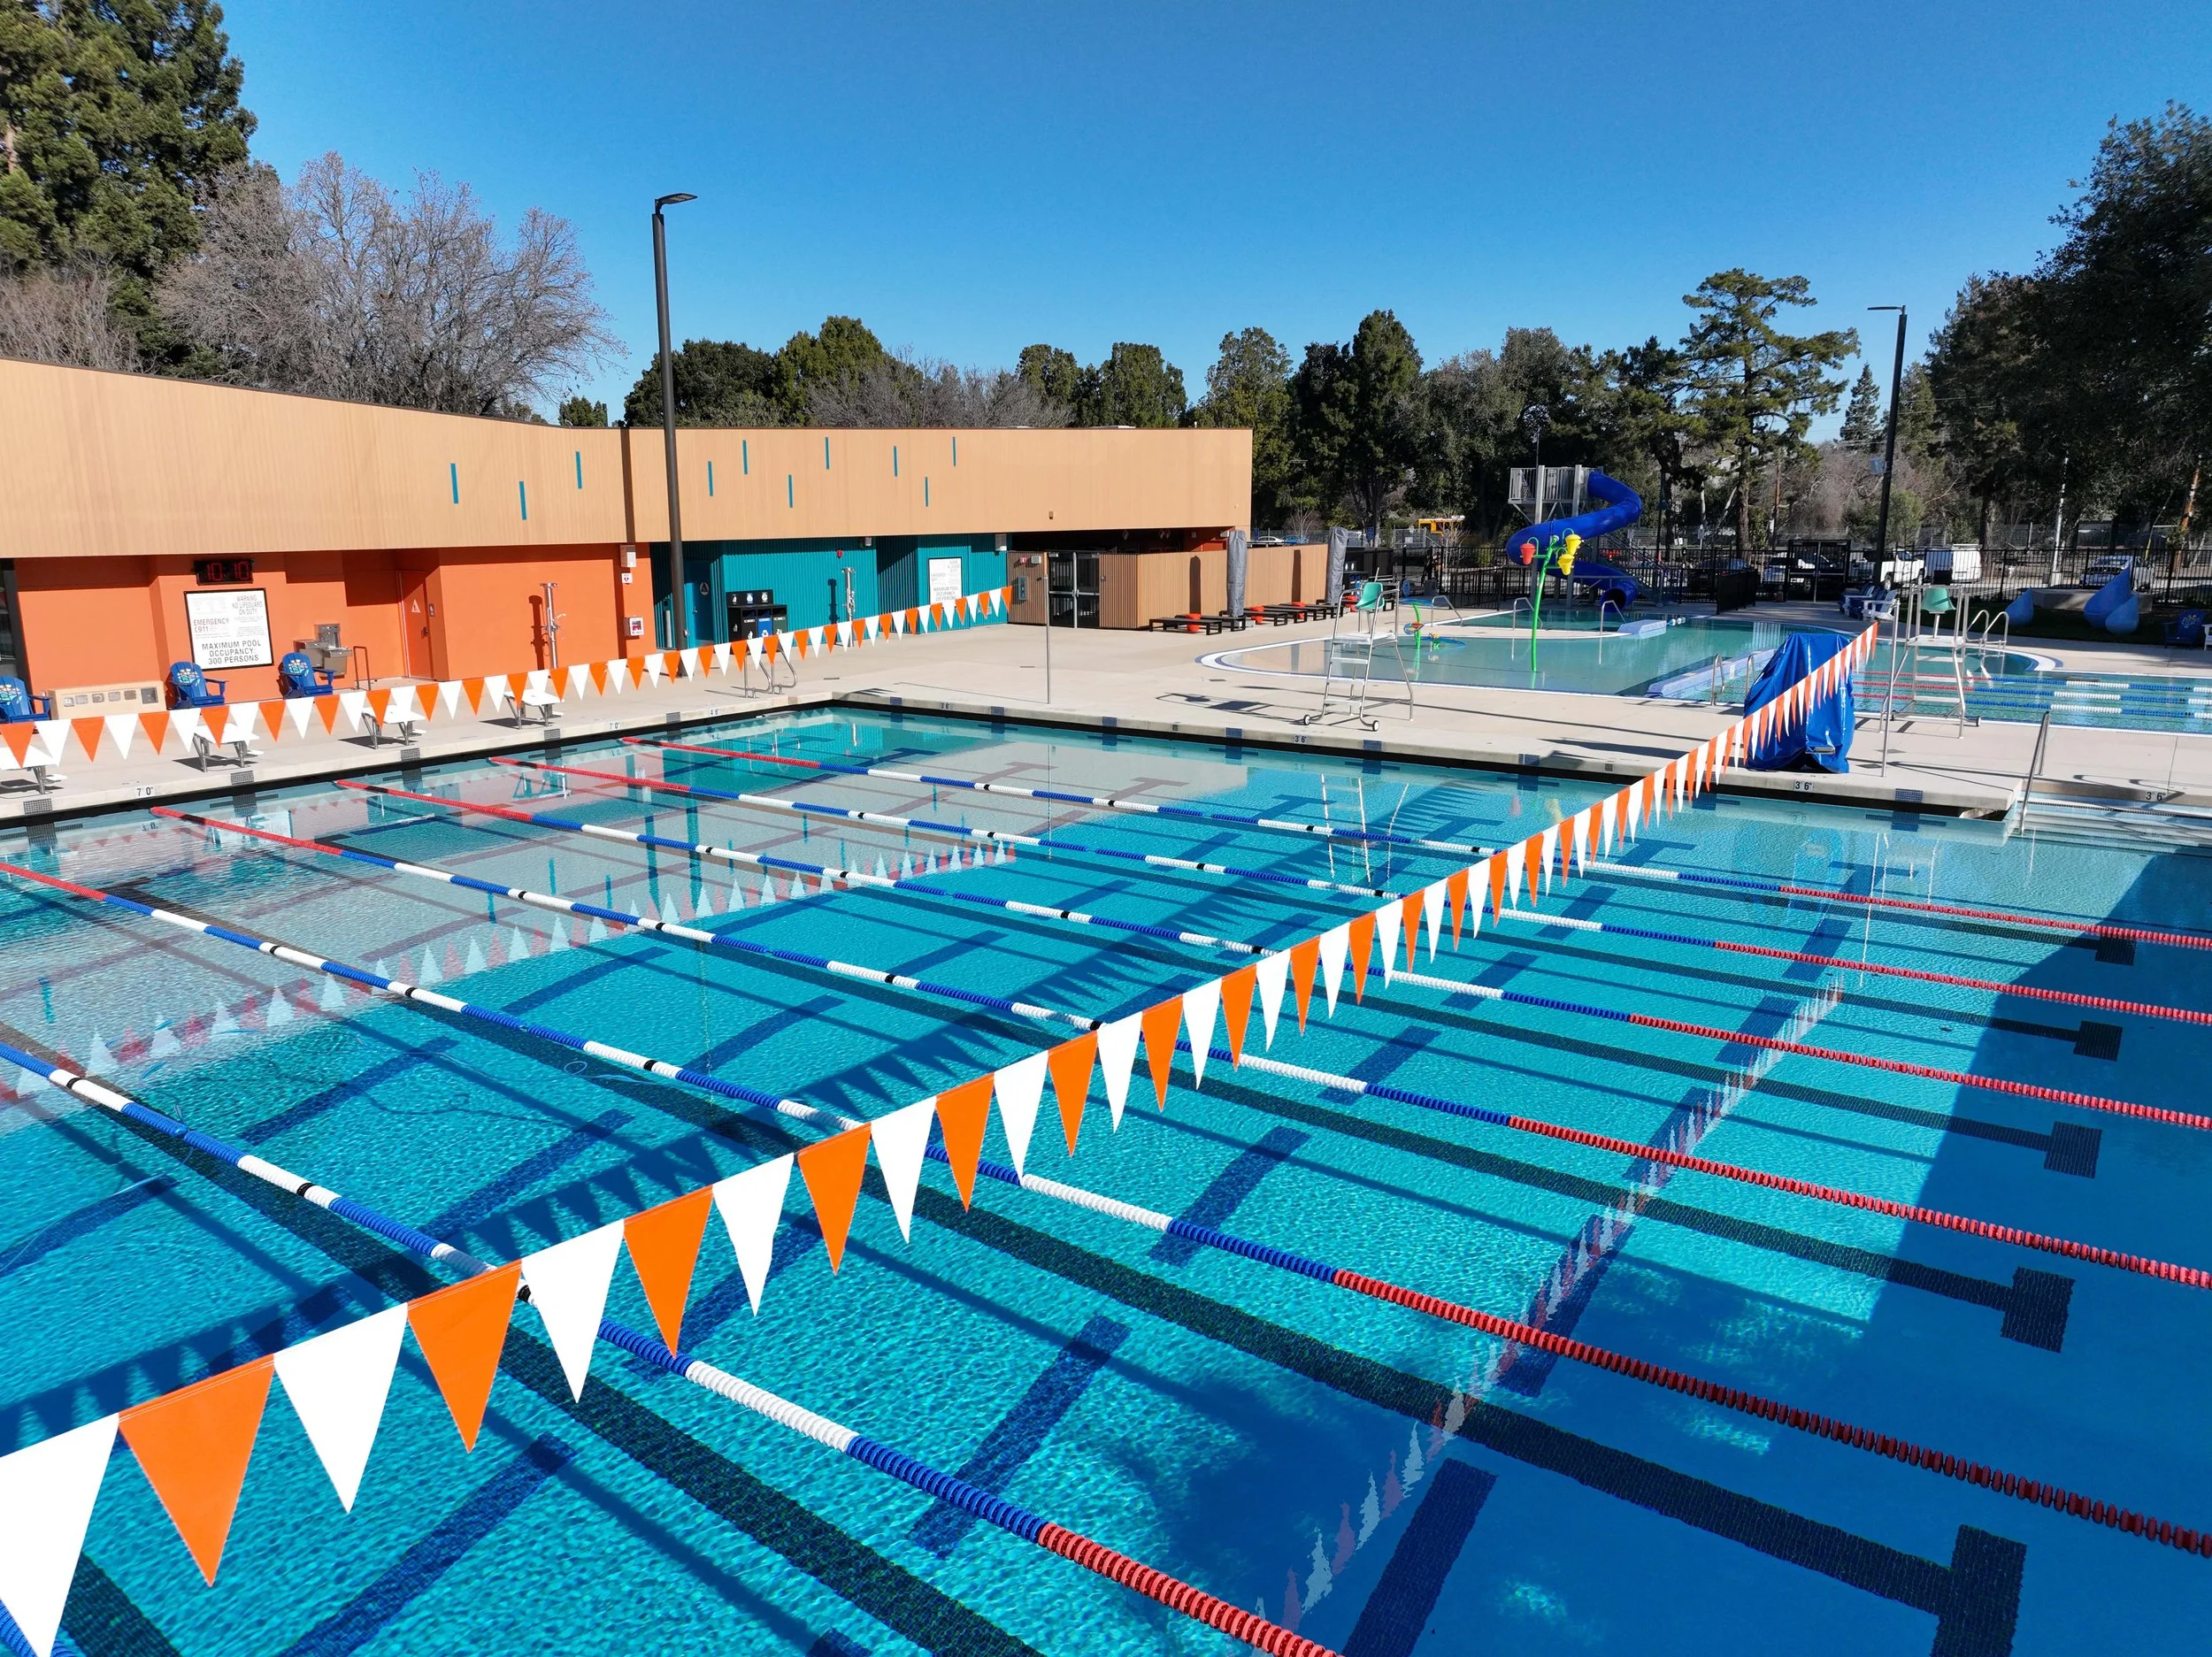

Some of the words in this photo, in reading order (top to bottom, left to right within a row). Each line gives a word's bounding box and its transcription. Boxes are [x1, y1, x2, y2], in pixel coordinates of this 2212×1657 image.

[193, 618, 230, 626] EMERGENCY
[202, 641, 240, 650] MAXIMUM
[208, 656, 223, 665] 300
[224, 655, 259, 664] PERSONS
